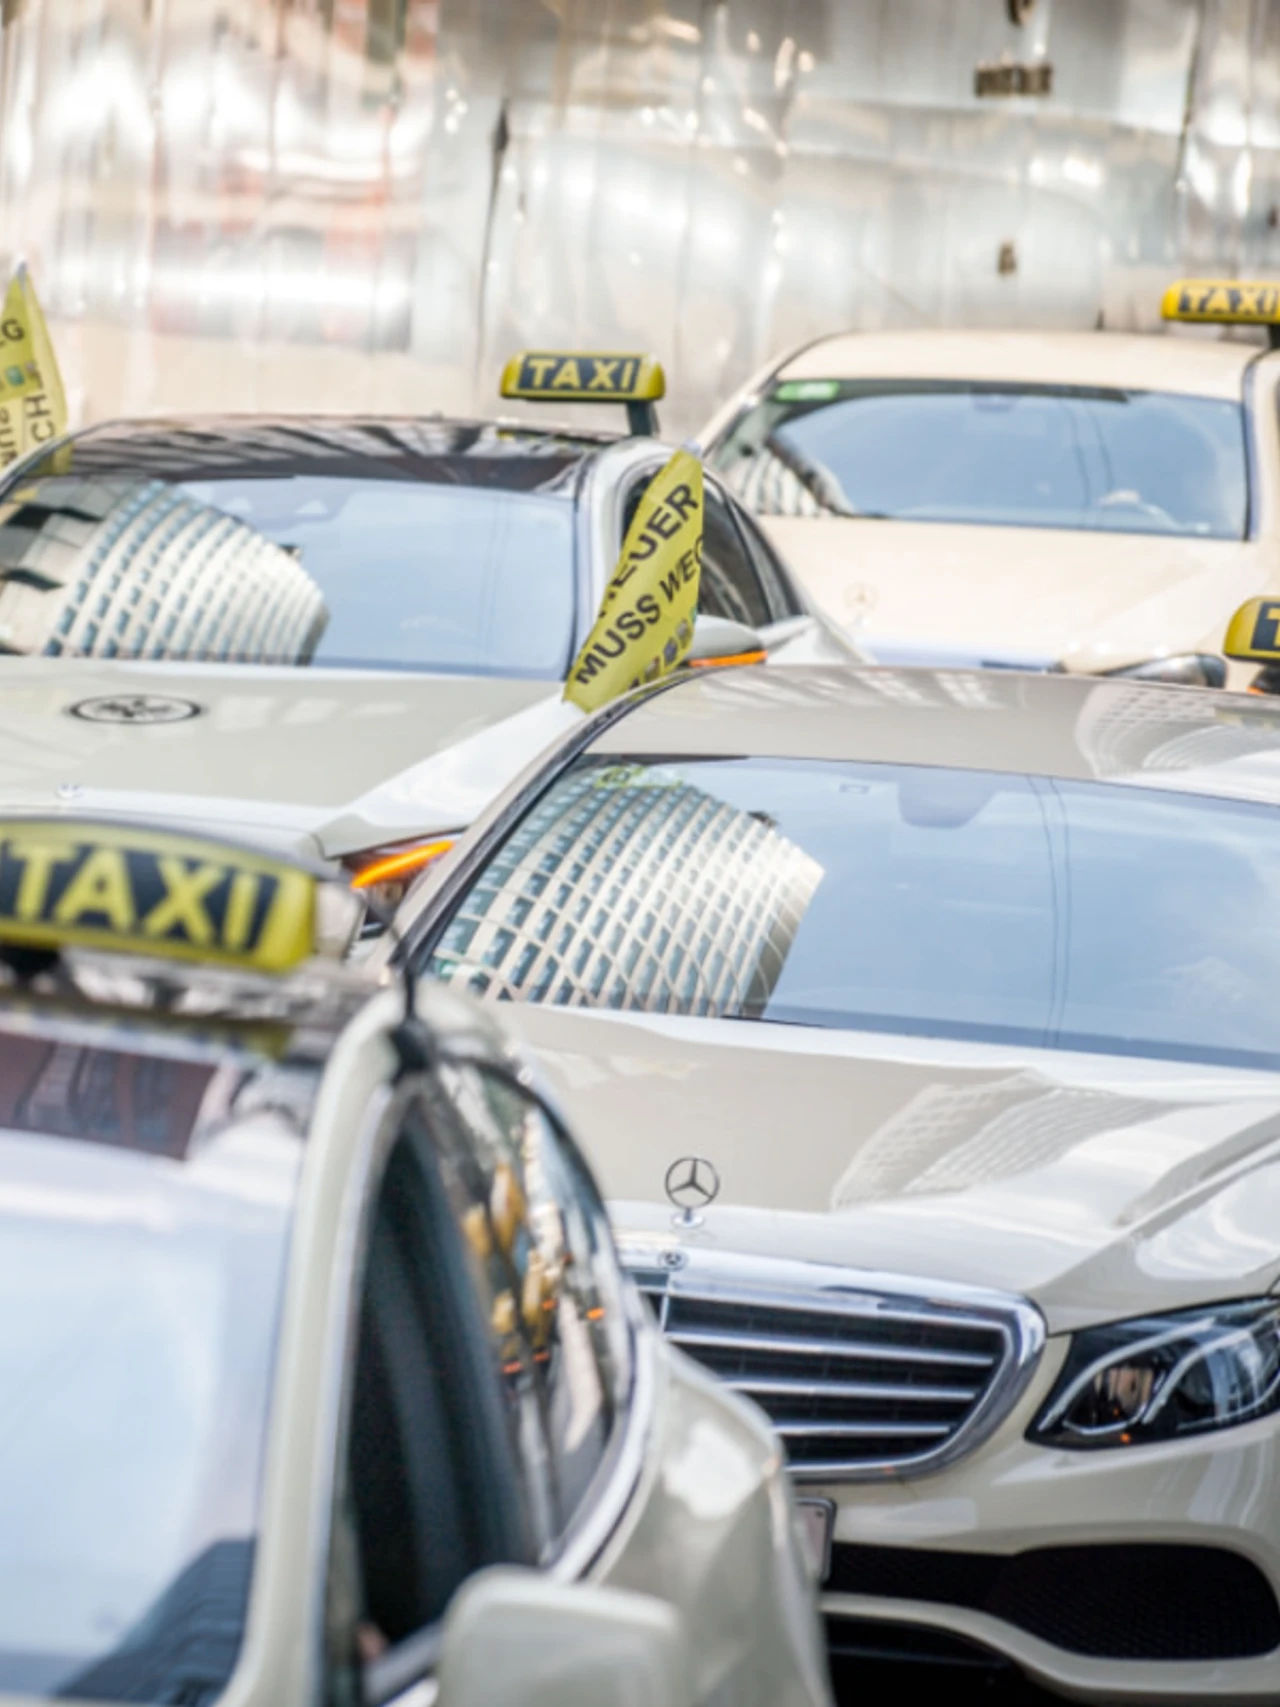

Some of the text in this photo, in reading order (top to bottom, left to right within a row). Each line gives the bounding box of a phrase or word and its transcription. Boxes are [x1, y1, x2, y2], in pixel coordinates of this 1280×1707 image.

[1183, 286, 1275, 314] TAXI
[528, 358, 634, 389] TAXI
[575, 594, 661, 685] MUSS
[9, 846, 260, 949] TAXI
